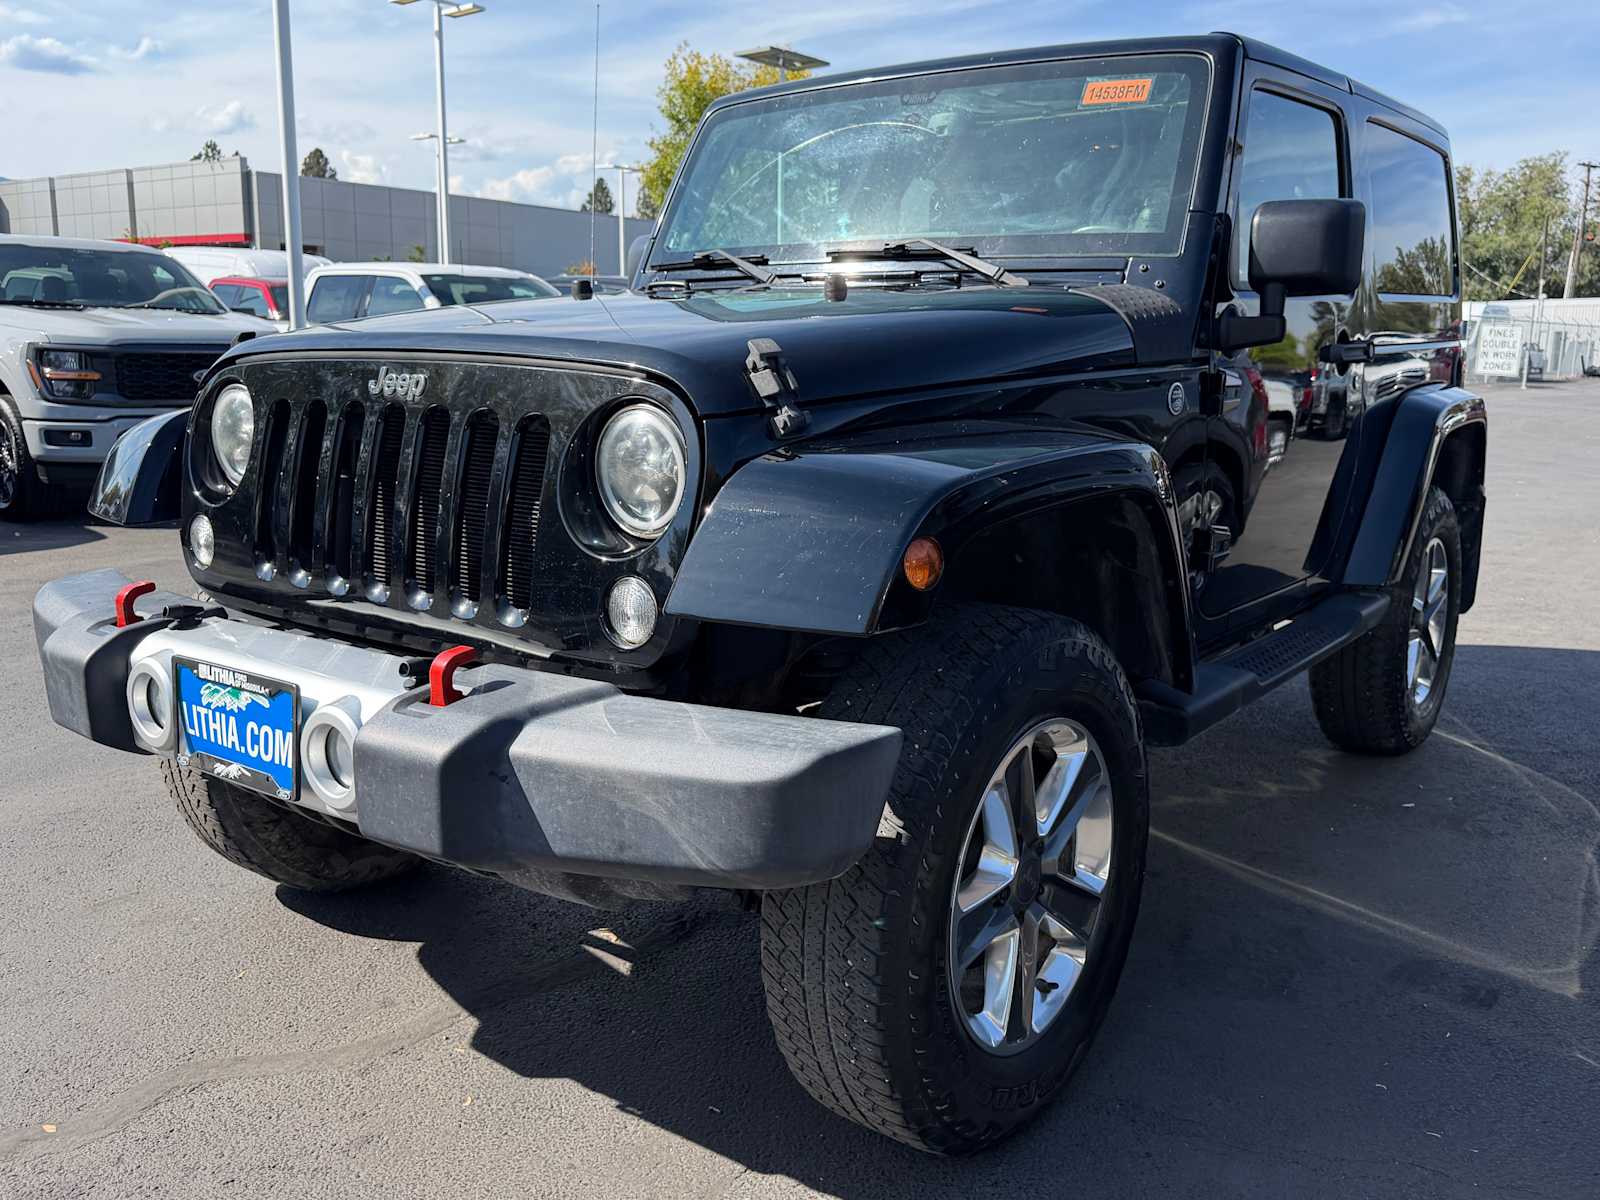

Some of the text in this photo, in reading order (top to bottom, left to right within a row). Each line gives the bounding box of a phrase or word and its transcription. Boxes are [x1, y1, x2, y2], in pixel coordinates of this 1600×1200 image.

[1089, 84, 1146, 100] 14538FM
[1482, 339, 1517, 349] DOUBLE
[1482, 362, 1513, 371] ZONES
[368, 366, 426, 401] Jeep
[207, 664, 236, 688] LITHIA
[182, 701, 293, 769] LITHIA.COM
